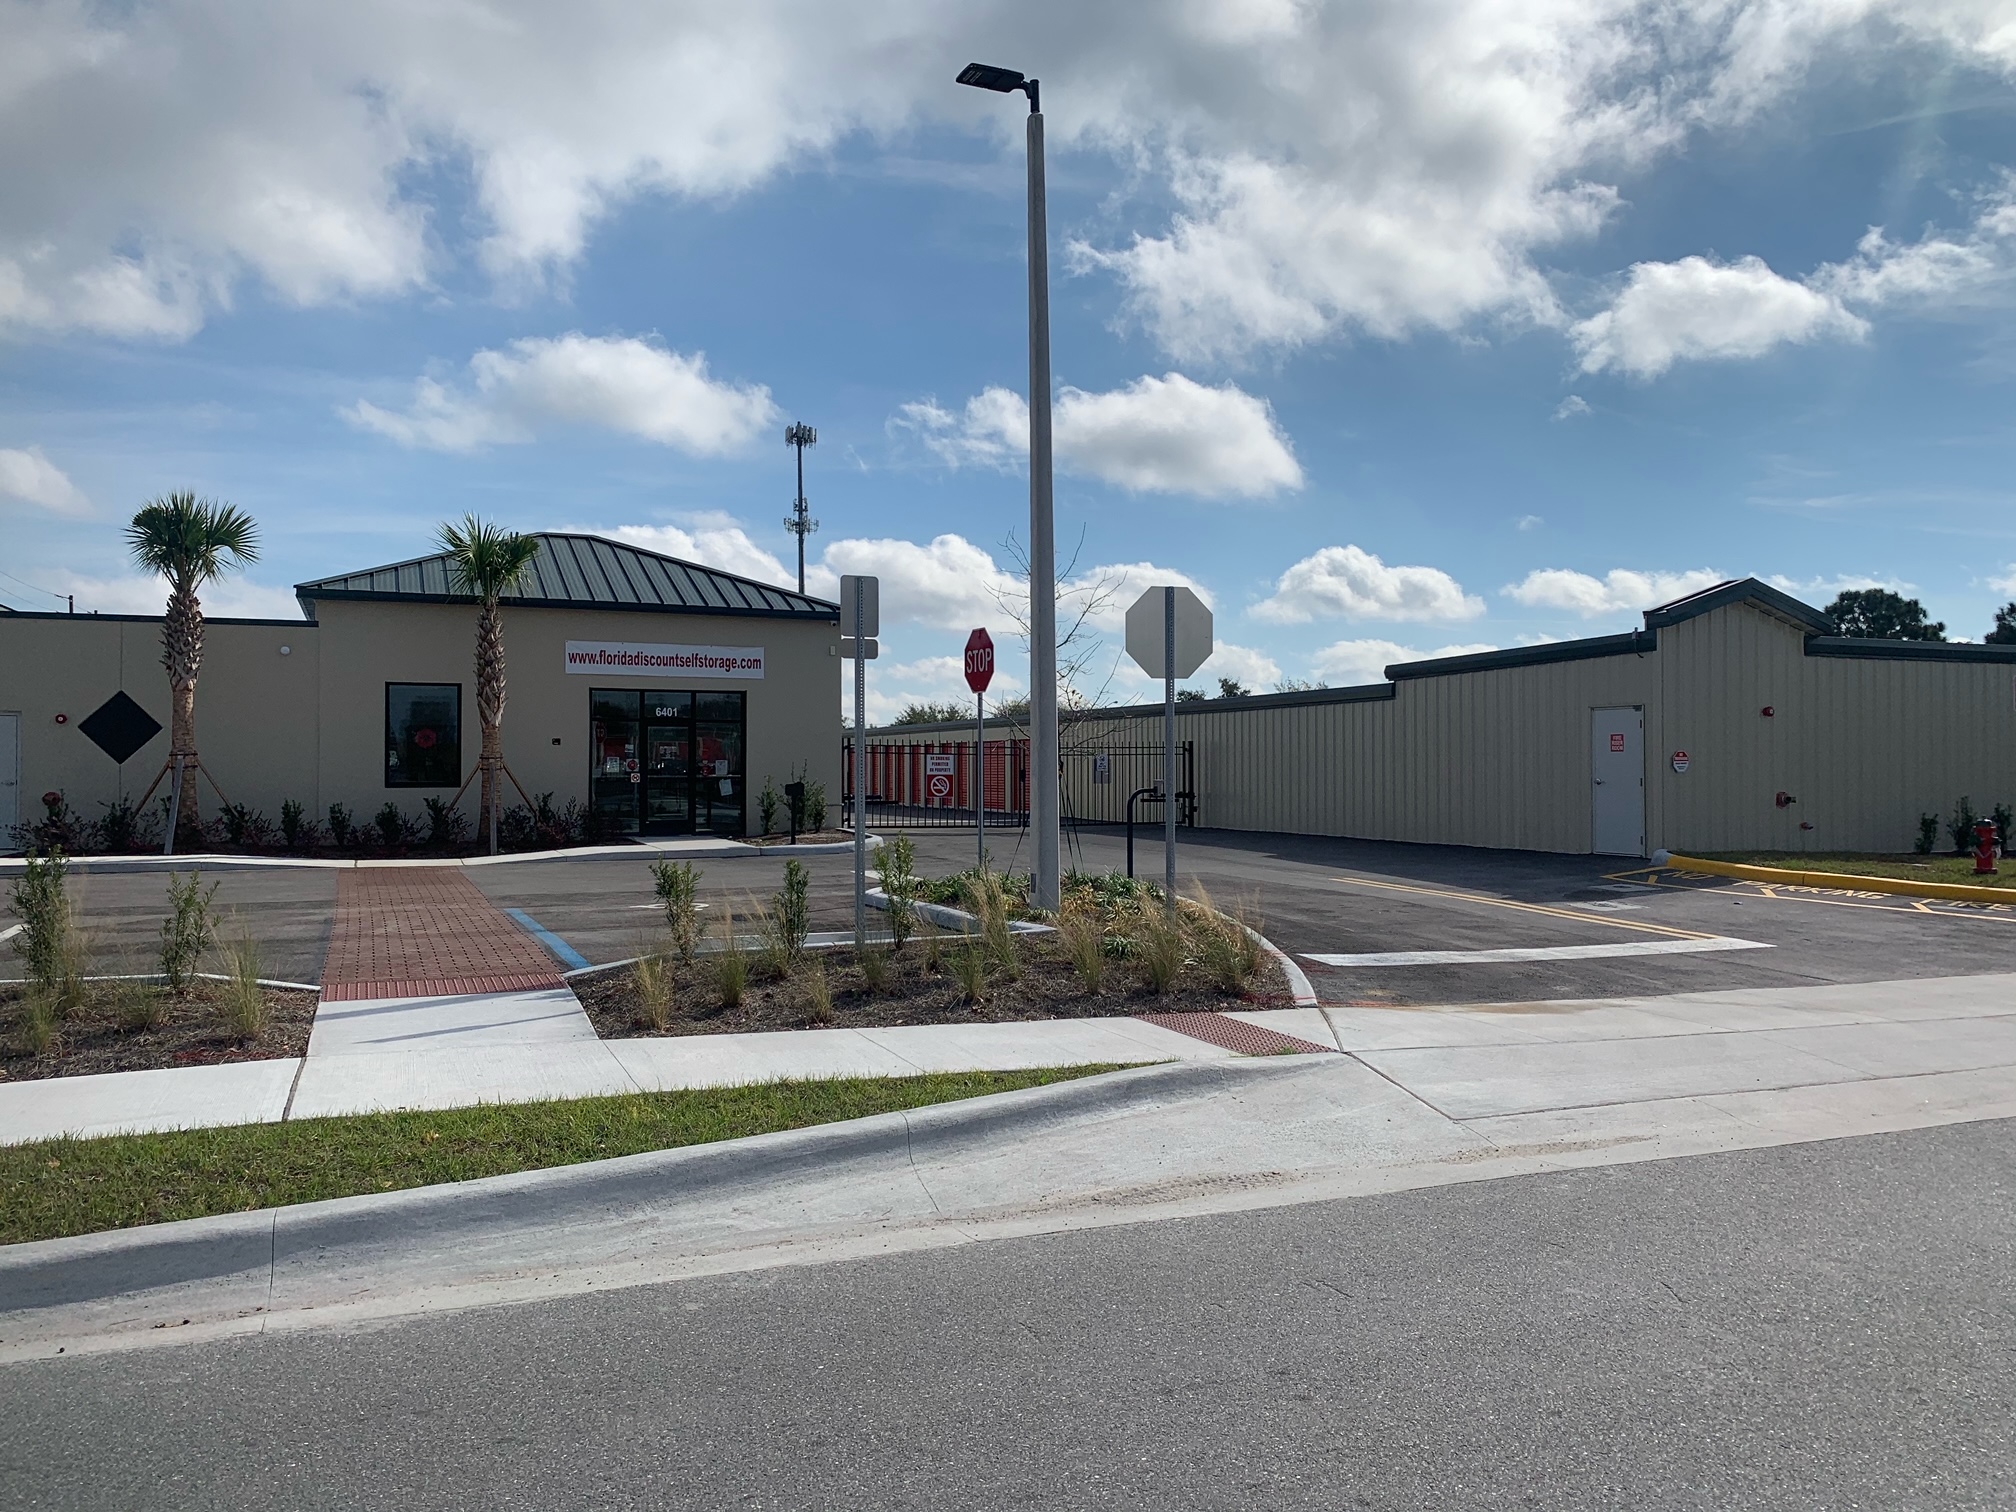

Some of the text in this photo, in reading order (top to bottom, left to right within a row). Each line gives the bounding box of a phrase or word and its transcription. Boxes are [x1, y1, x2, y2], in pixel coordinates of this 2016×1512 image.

[568, 650, 761, 672] www.floridadiscountselfstorage.com
[966, 648, 992, 674] STOP
[656, 707, 678, 717] 6401
[1732, 880, 1892, 900] PARKING
